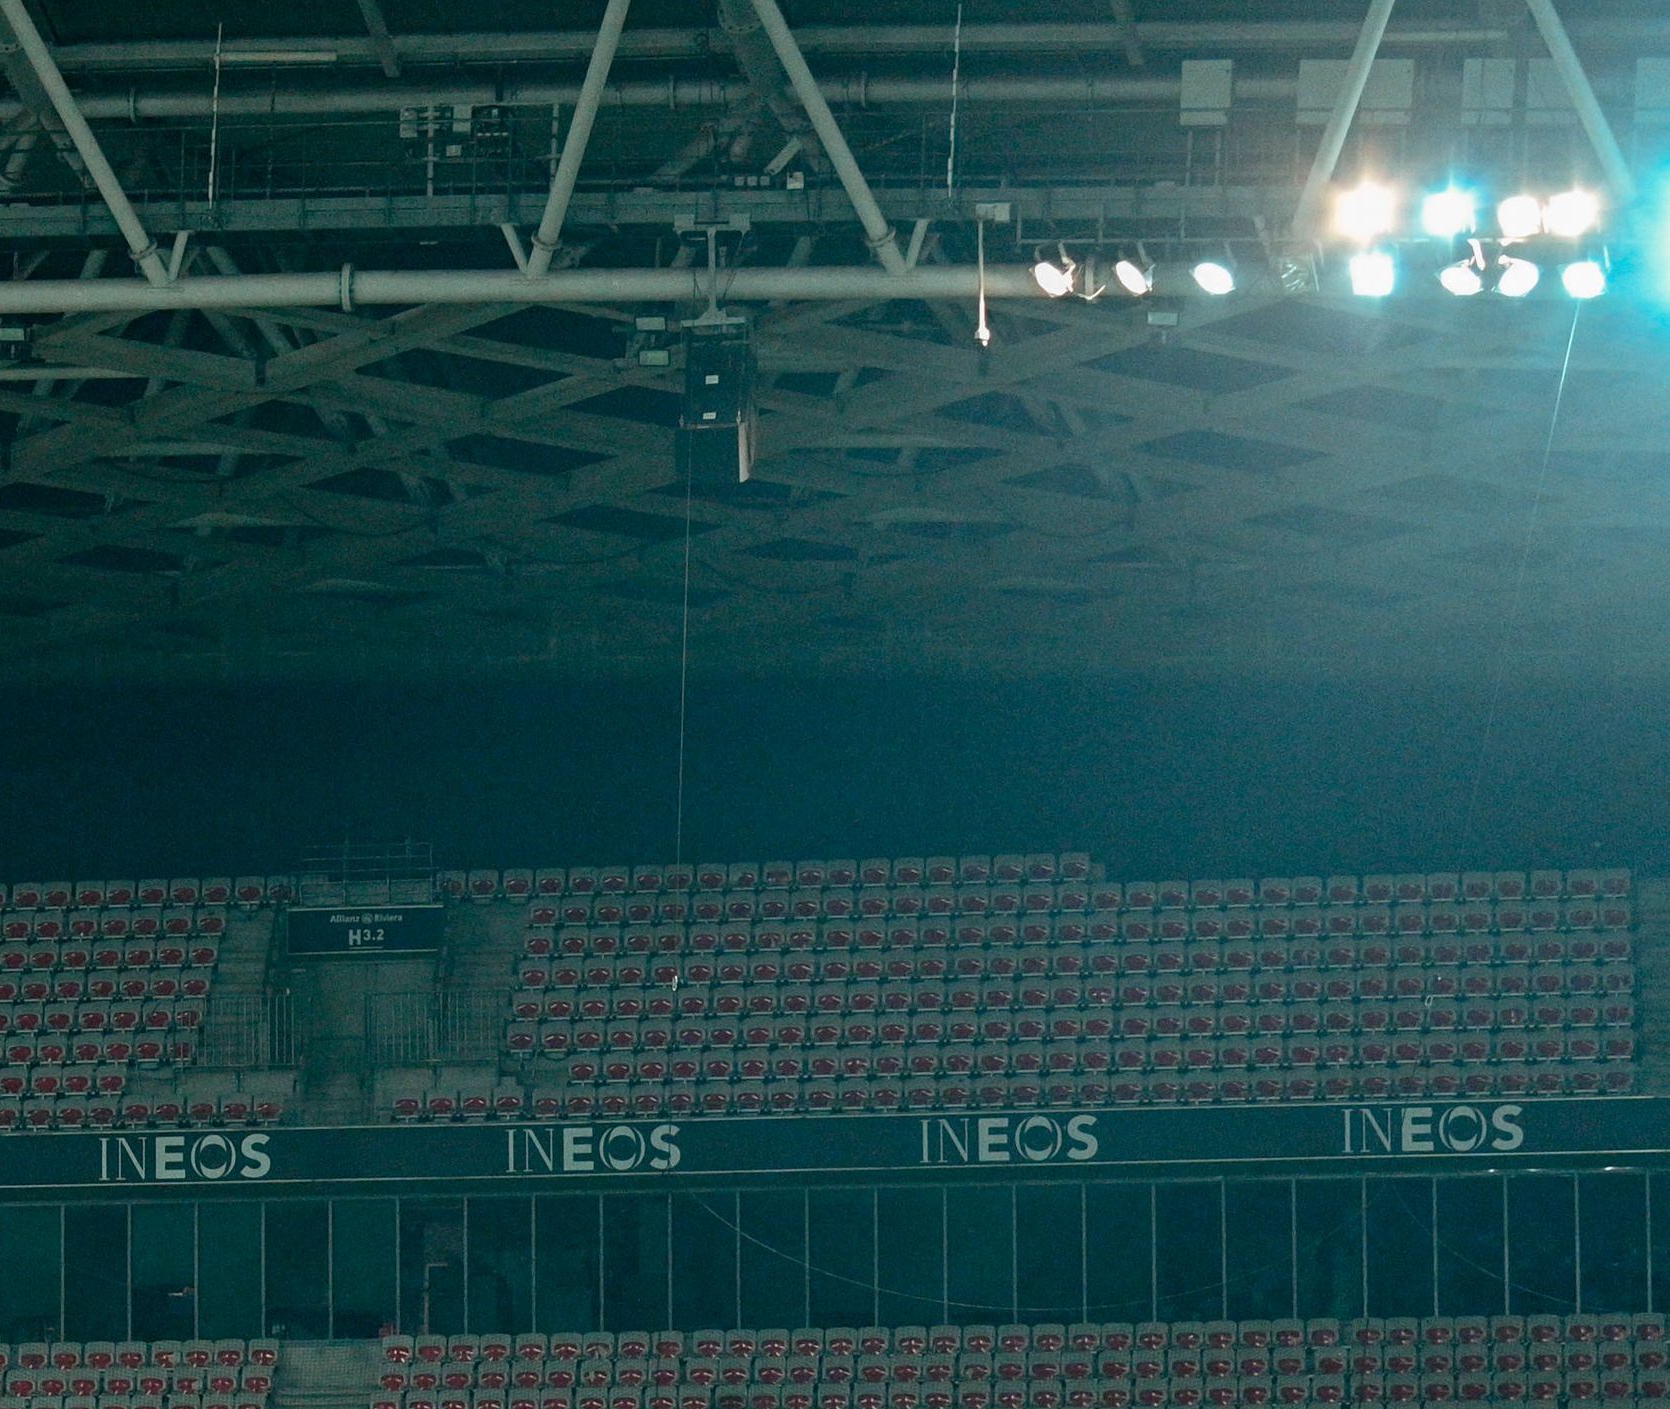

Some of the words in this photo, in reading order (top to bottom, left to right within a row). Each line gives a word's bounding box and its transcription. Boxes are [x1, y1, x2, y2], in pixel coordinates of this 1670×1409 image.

[507, 1123, 682, 1173] INEOS
[920, 1115, 1100, 1163] INEOS
[1342, 1103, 1525, 1153] INEOS
[99, 1132, 272, 1181] INEOS
